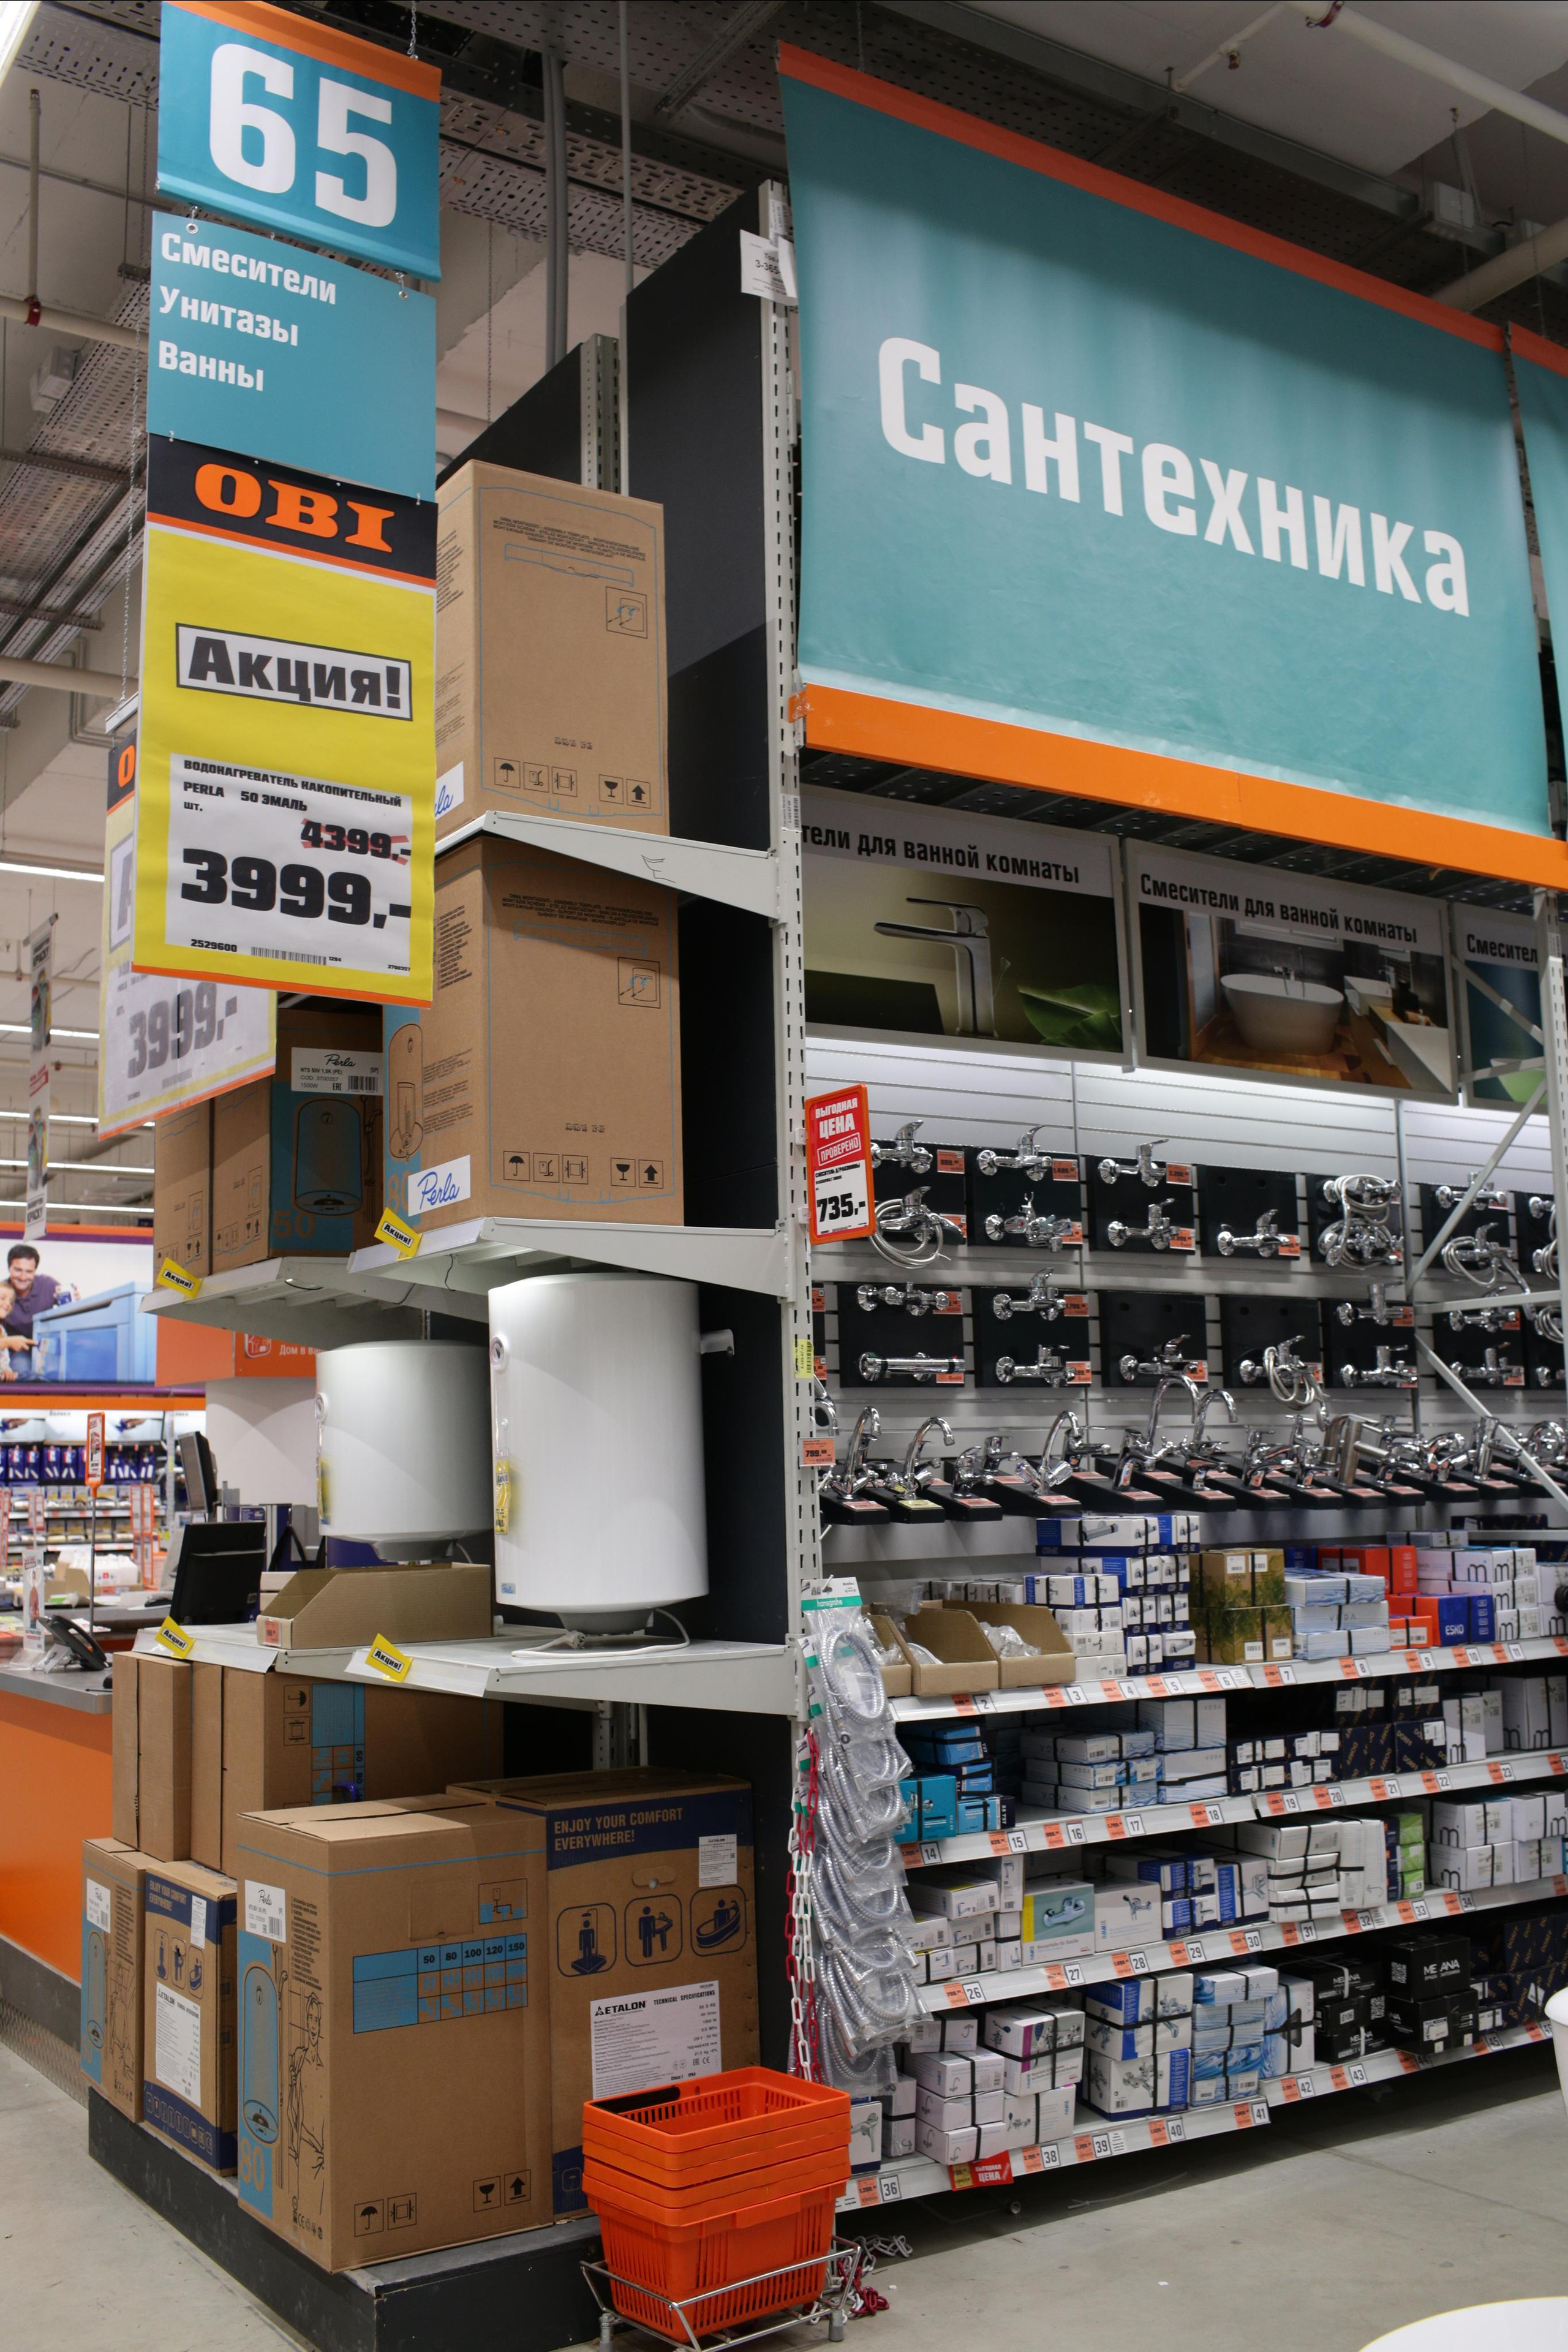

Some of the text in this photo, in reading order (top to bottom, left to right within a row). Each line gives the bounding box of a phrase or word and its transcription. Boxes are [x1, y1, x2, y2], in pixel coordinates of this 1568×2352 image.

[209, 43, 397, 227] 65
[161, 233, 336, 305] Смесители
[159, 285, 298, 347] Унитазы
[158, 340, 264, 392] Ванны
[878, 337, 1469, 617] Сантехника
[195, 464, 395, 552] OBI
[188, 636, 403, 710] Акция!
[184, 760, 402, 807] ВОДОНАГРЕВАТЕЛЬ НАКОПИТЕЛЬНЫЙ
[183, 782, 307, 812] PERLA 50 ЭМАЛЬ
[858, 834, 896, 857] для
[903, 841, 979, 869] ванной
[986, 854, 1080, 884] комнаты
[1140, 873, 1417, 944] Смесители для ванной комнаты
[190, 938, 238, 952] 2529600
[1467, 933, 1538, 964] Смесител
[324, 1054, 356, 1067] Perla
[815, 1098, 858, 1119] ВЫГОДНАЯ
[819, 1113, 856, 1139] ЦЕНА
[821, 1137, 859, 1161] ПРОВЕРЕНО
[417, 1171, 460, 1210] Perla
[274, 1216, 315, 1238] 50
[383, 1224, 412, 1245] Акция!
[165, 1272, 192, 1289] Акция!
[279, 1344, 298, 1355] Дом
[817, 1598, 843, 1608] hansgrohe
[1445, 1624, 1464, 1636] ESKO
[163, 1629, 186, 1649] Акция!
[1469, 1652, 1479, 1661] 10
[1513, 1648, 1521, 1657] 11
[374, 1650, 402, 1671] Акция!
[1424, 1657, 1431, 1666] 9
[1360, 1664, 1366, 1673] 8
[1224, 1676, 1231, 1686] 6
[1284, 1671, 1290, 1681] 7
[1128, 1686, 1134, 1695] 4
[1172, 1682, 1178, 1691] 5
[1072, 1691, 1081, 1701] 3
[980, 1700, 990, 1709] 2
[1502, 1767, 1512, 1777] 23
[1440, 1777, 1450, 1787] 22
[1389, 1784, 1398, 1793] 21
[1331, 1792, 1340, 1802] 20
[1286, 1798, 1295, 1809] 19
[554, 1807, 684, 1834] ENJOY YOUR COMFORT
[1208, 1809, 1219, 1820] 18
[1130, 1820, 1139, 1832] 17
[1071, 1828, 1082, 1839] 16
[555, 1830, 635, 1852] EVERYWHERE!
[1012, 1837, 1023, 1849] 15
[924, 1848, 937, 1860] 14
[1463, 1897, 1472, 1908] 34
[1415, 1905, 1426, 1916] 33
[1362, 1916, 1372, 1926] 32
[1303, 1926, 1313, 1937] 31
[1248, 1935, 1259, 1948] 30
[423, 1942, 525, 1964] 50 80 100 120 150
[1190, 1947, 1202, 1959] 29
[1133, 1957, 1145, 1969] 28
[1423, 1959, 1460, 1975] MEANA
[1068, 1969, 1080, 1981] 27
[967, 1987, 982, 1999] 26
[605, 1990, 715, 2015] ETALON TECHNICAL SPECIFICATIONS
[1490, 2036, 1500, 2047] 45
[1353, 2070, 1364, 2081] 43
[1300, 2081, 1311, 2093] 42
[1256, 2108, 1265, 2120] 41
[1170, 2124, 1182, 2136] 40
[1095, 2139, 1107, 2153] 39
[1044, 2150, 1057, 2163] 38
[240, 2137, 265, 2192] 80
[978, 2172, 1001, 2182] ЦЕНА
[883, 2182, 898, 2196] 36
